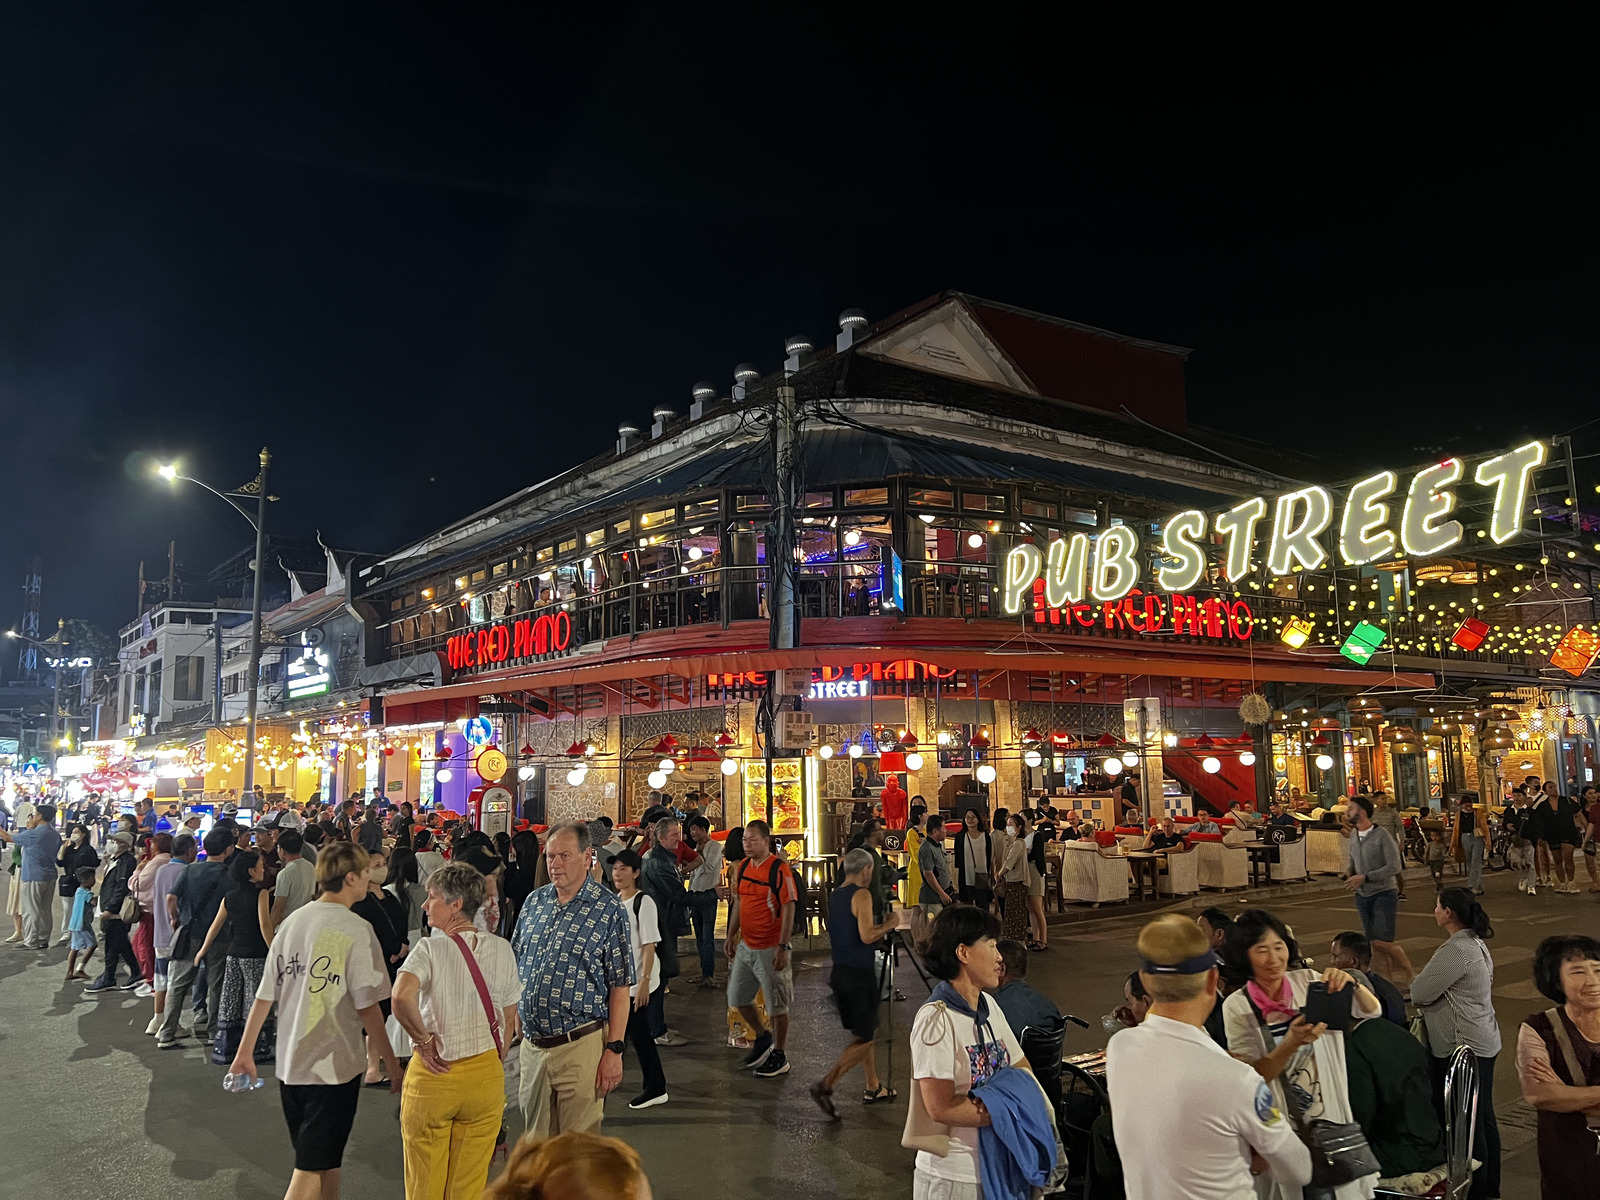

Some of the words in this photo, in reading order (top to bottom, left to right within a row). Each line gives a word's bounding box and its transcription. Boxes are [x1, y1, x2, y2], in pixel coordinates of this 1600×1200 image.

[1004, 525, 1140, 614] PUB
[1157, 440, 1548, 592] STREET
[446, 632, 475, 669] THE
[477, 625, 510, 665] RED
[513, 611, 571, 658] PIANO
[1172, 593, 1253, 640] PIANO
